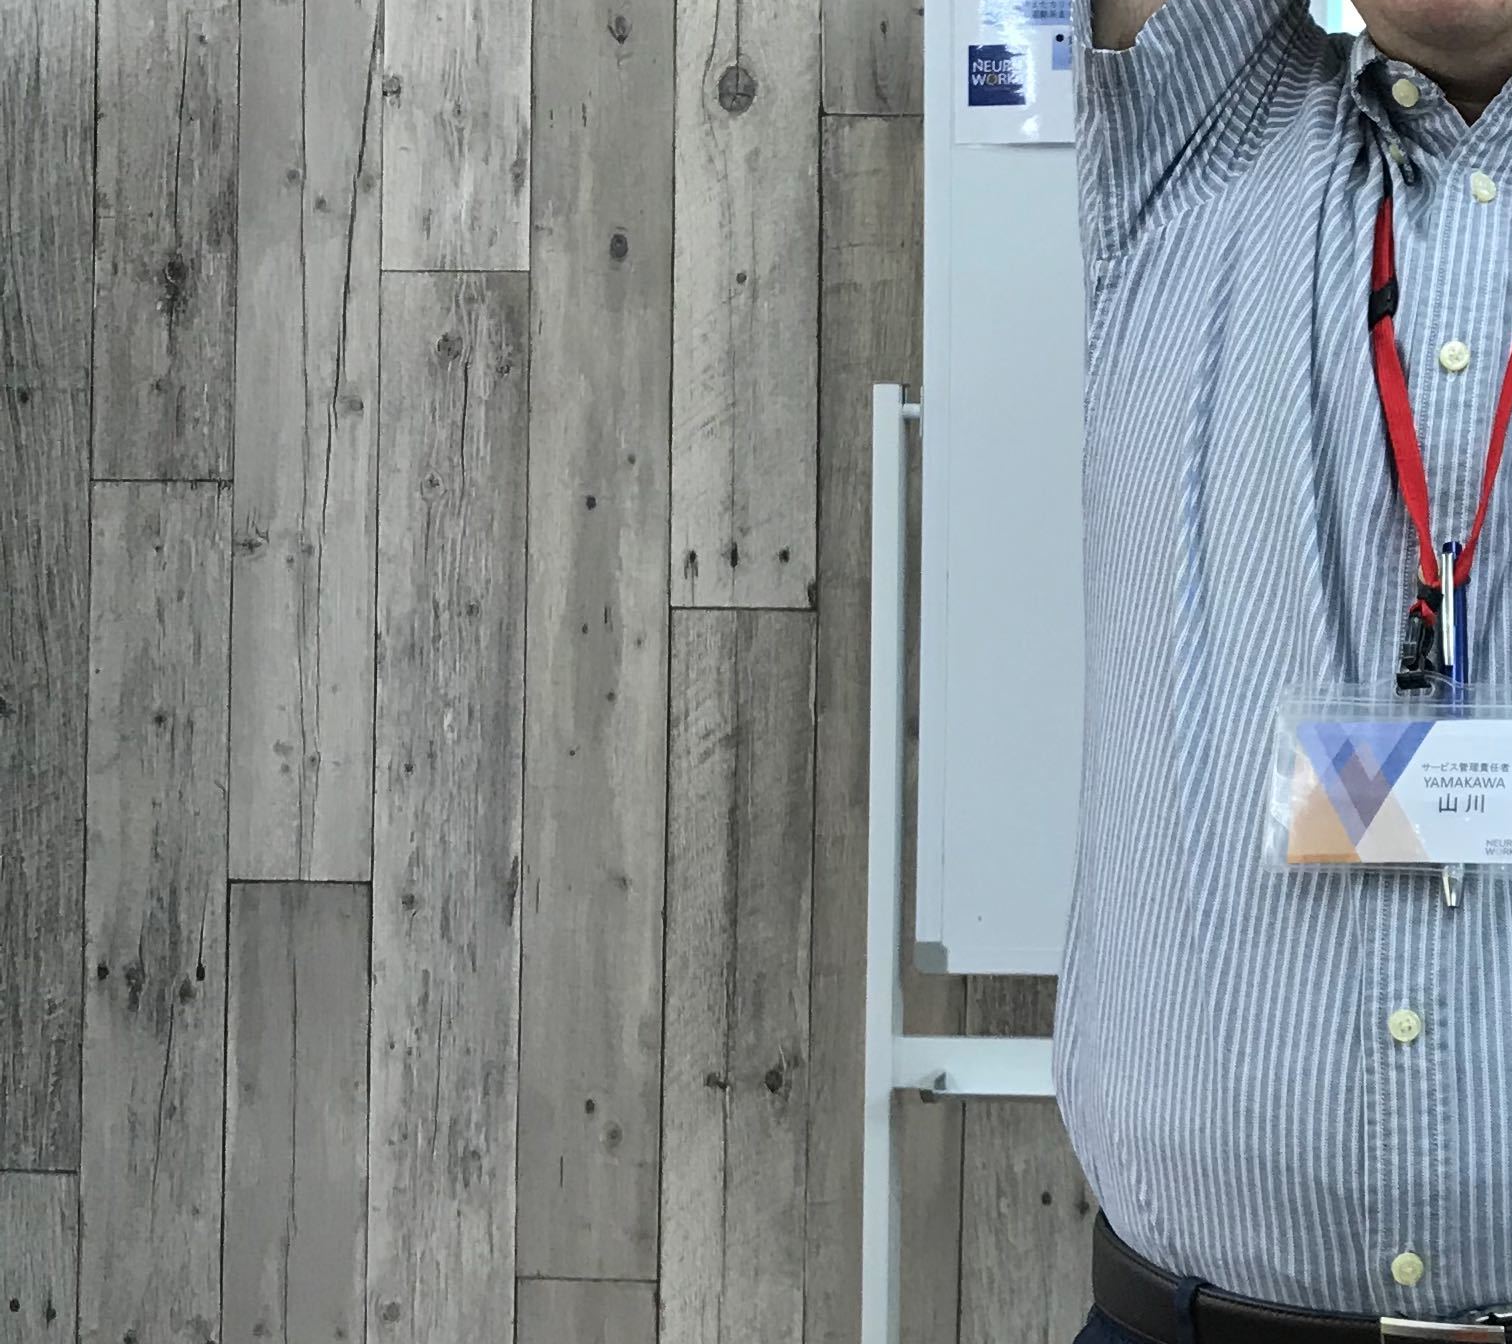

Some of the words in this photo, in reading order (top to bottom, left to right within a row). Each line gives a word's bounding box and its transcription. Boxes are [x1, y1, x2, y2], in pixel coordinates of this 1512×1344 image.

[972, 58, 1016, 73] NEUR
[972, 72, 1022, 86] WORK
[1424, 777, 1505, 788] YAMAKAWA
[1439, 793, 1485, 813] 山川
